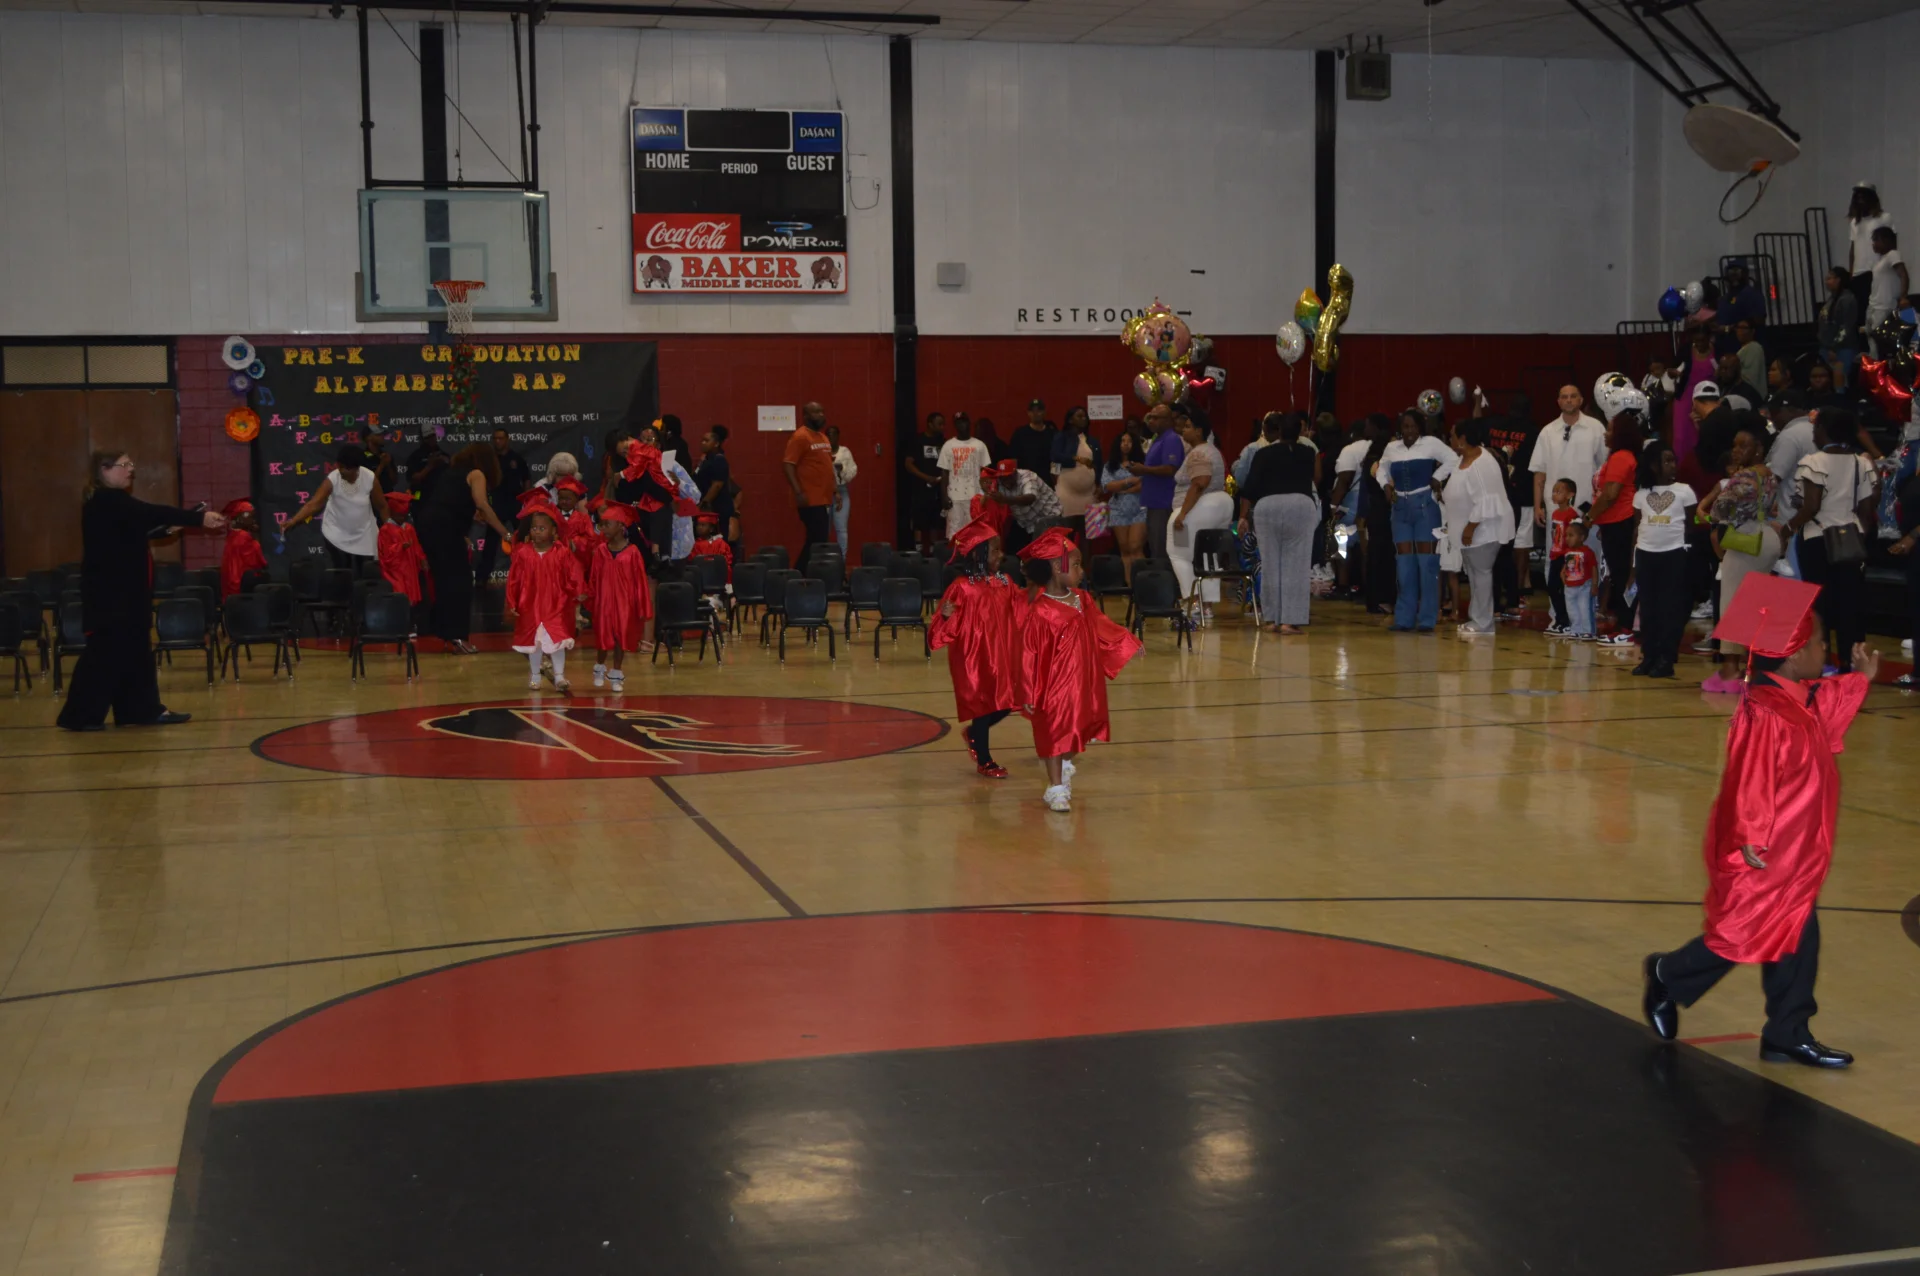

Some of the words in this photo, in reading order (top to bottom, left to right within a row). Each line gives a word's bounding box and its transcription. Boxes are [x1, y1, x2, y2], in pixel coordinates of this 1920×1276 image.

[641, 125, 677, 136] DASANI
[800, 127, 835, 138] DASANI
[646, 153, 690, 169] HOME
[787, 155, 834, 171] GUEST
[721, 163, 758, 174] PERIOD
[646, 221, 731, 250] Coca-Cola
[681, 257, 801, 278] BAKER
[681, 279, 740, 289] MIDDLE
[744, 279, 802, 289] SCHOOL
[283, 346, 364, 365] PRE-K
[421, 344, 581, 363] GRDUATION
[512, 372, 567, 391] RAP
[493, 415, 505, 424] BE
[508, 414, 525, 423] THE
[530, 414, 556, 423] PLACE
[561, 414, 578, 422] FOR
[582, 413, 600, 421] ME!
[404, 434, 420, 443] WE
[446, 434, 466, 442] OUR
[469, 433, 493, 442] BEST
[308, 546, 324, 554] WE
